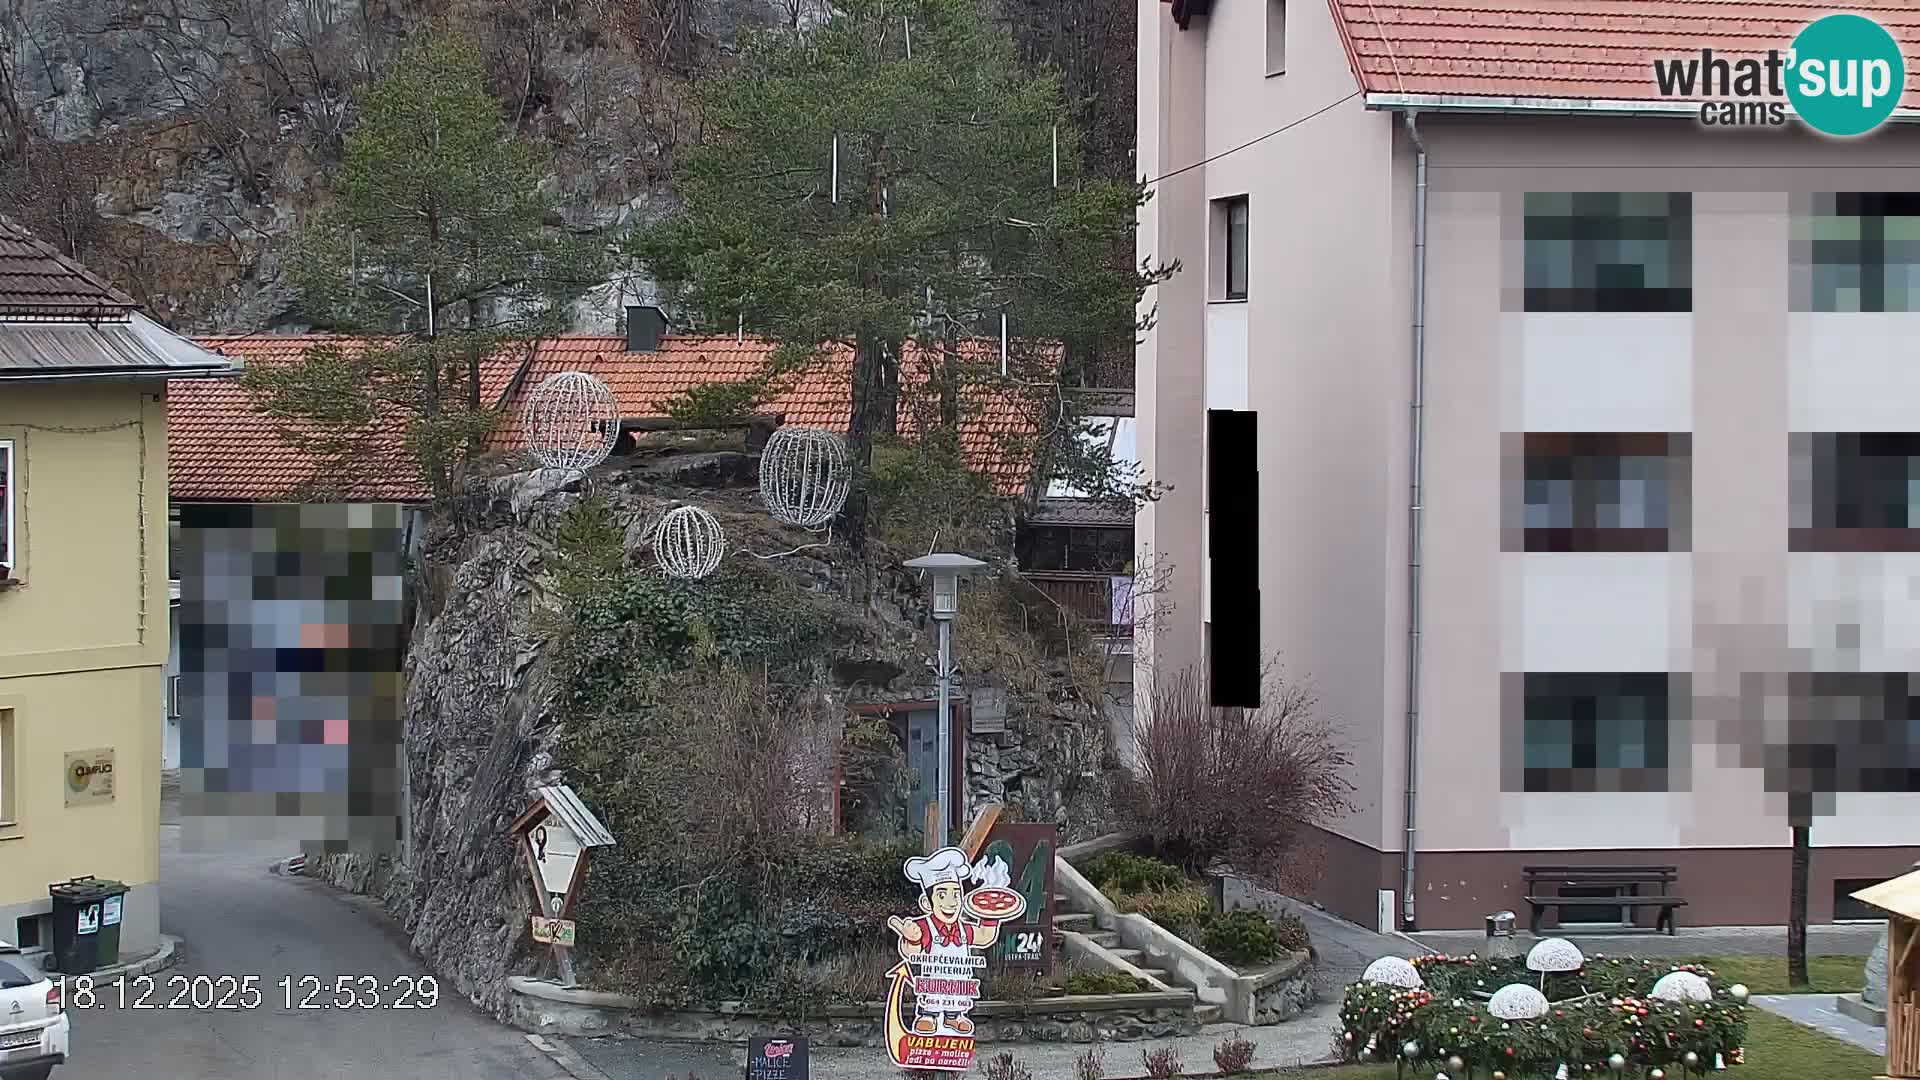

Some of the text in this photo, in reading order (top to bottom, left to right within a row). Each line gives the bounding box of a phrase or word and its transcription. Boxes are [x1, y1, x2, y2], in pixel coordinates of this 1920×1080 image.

[923, 965, 971, 975] IN PICERIJA
[915, 978, 977, 996] KURNIK
